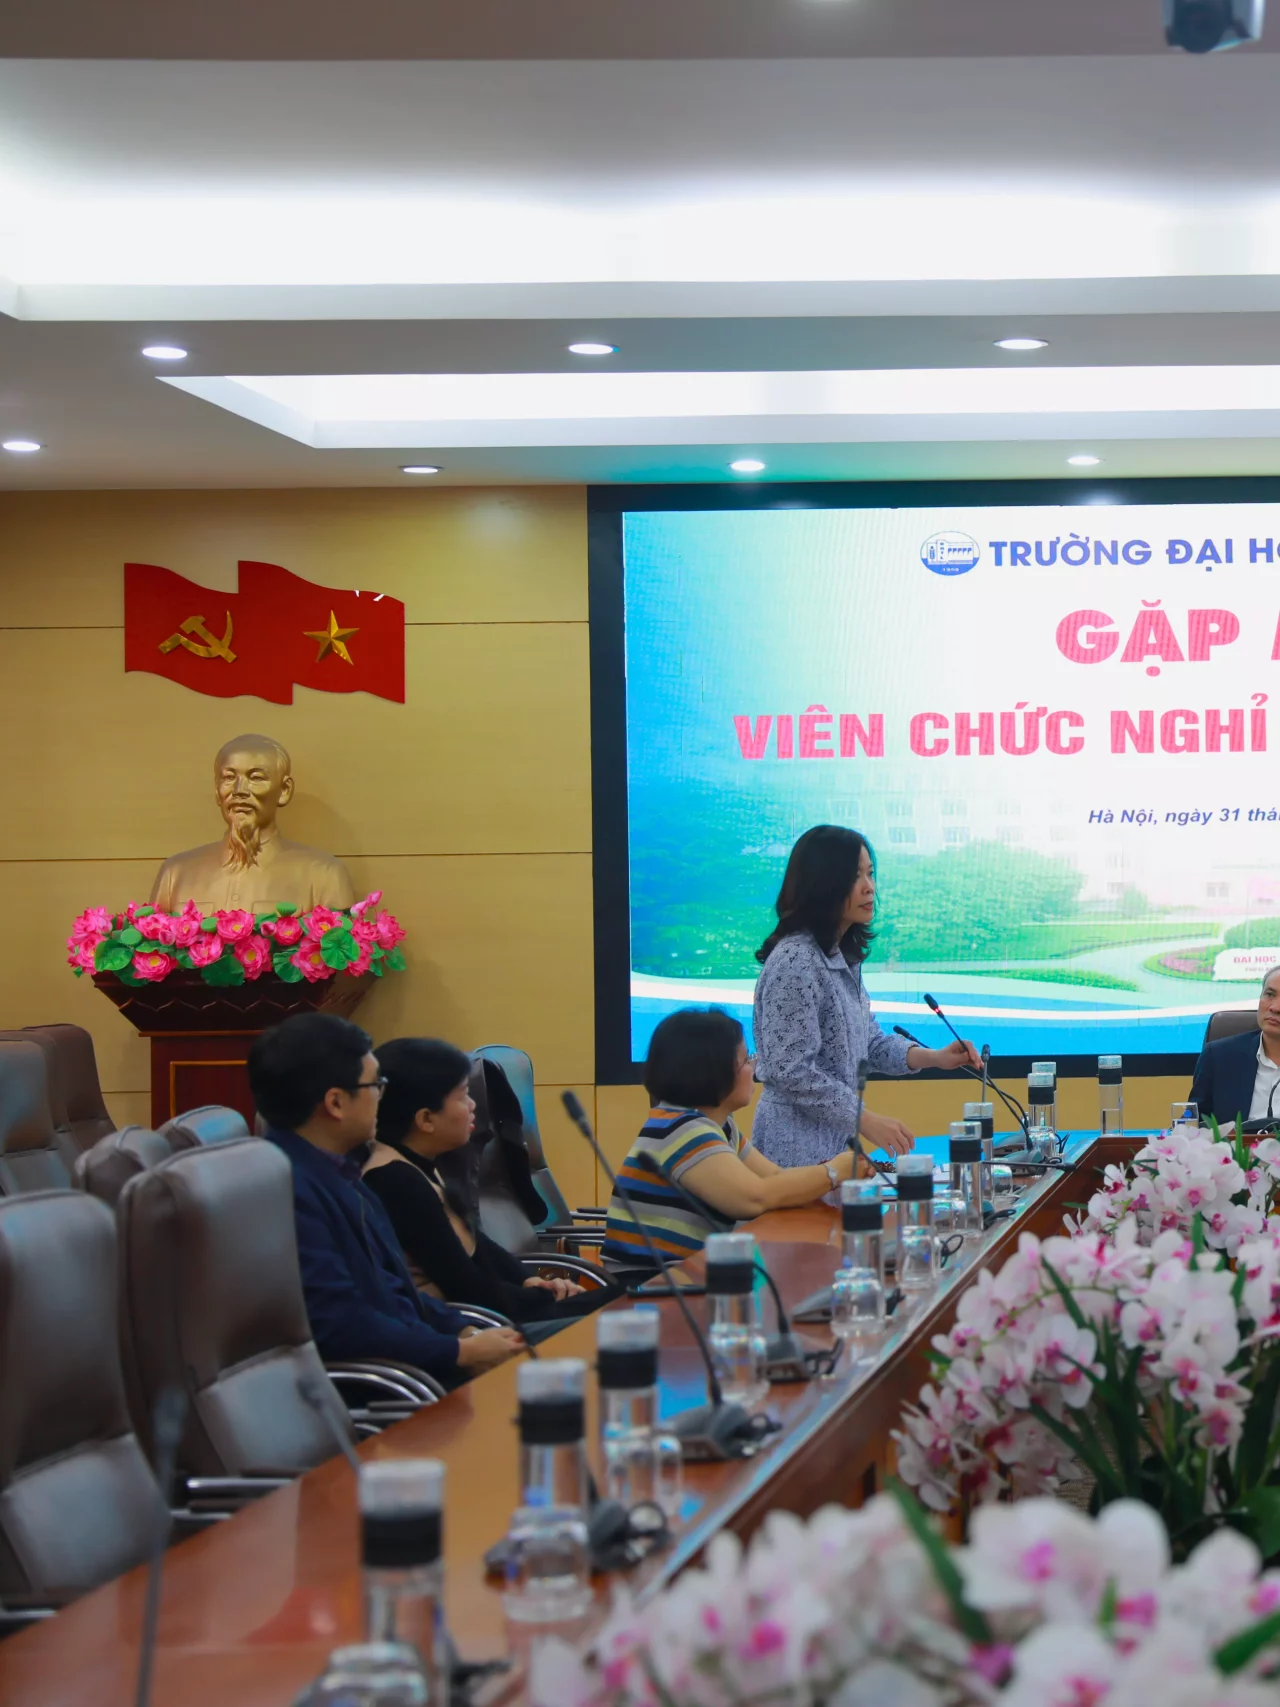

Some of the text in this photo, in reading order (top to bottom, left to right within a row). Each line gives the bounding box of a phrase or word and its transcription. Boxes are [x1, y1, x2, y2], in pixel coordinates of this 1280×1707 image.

[988, 532, 1152, 567] TRƯỜNG
[1165, 538, 1234, 572] ĐẠI
[1055, 599, 1241, 677] GẶP
[733, 704, 885, 760] VIÊN
[909, 701, 1085, 757] CHỨC
[1110, 692, 1269, 755] NGHỈ
[1088, 809, 1115, 824] Hà
[1120, 809, 1159, 826] Nội,
[1165, 809, 1213, 827] ngày
[1219, 807, 1241, 823] 31
